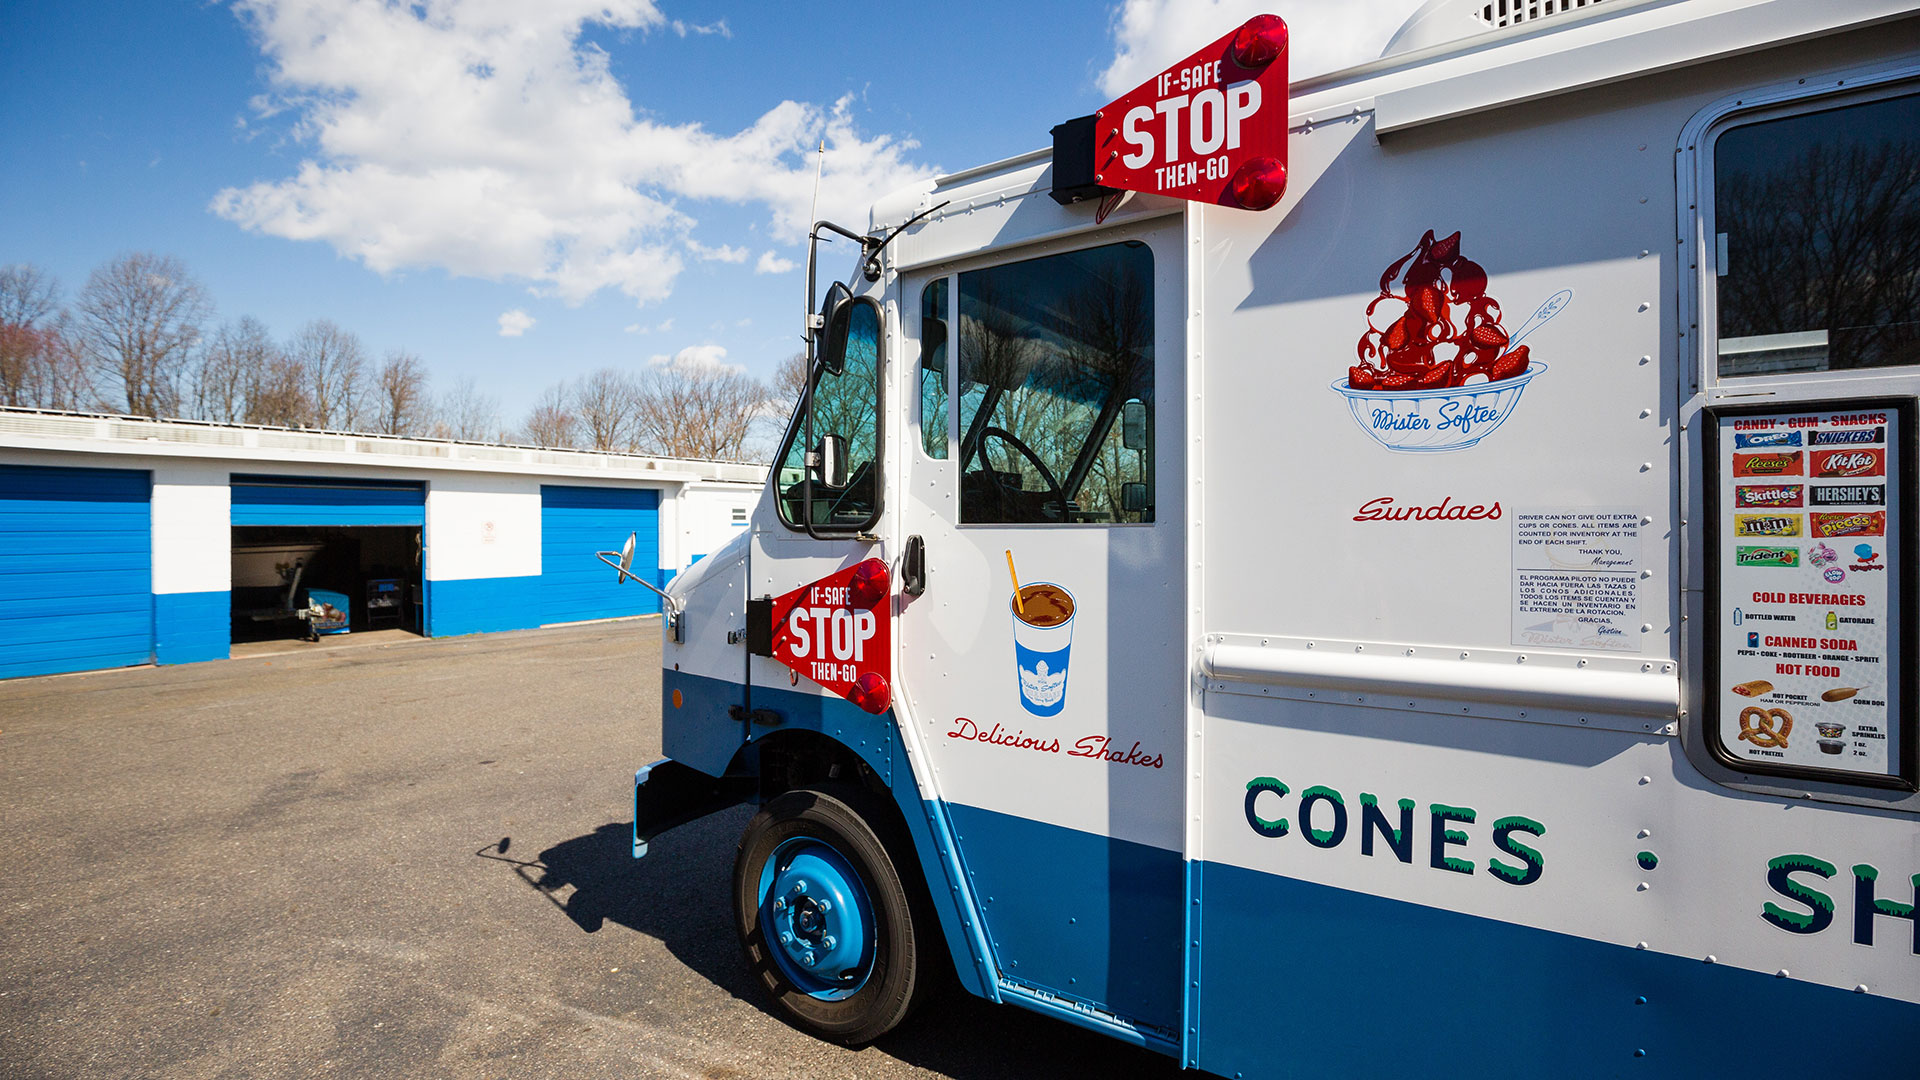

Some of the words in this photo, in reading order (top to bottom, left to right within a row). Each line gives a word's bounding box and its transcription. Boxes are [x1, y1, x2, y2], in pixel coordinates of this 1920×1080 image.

[1157, 59, 1223, 97] IF-SAFE
[1122, 79, 1262, 170] STOP
[1155, 155, 1229, 190] THEN-GO
[1371, 408, 1431, 431] Mister
[1436, 401, 1500, 434] Softee
[1733, 418, 1777, 431] CANDY
[1788, 417, 1819, 429] GUM
[1831, 413, 1888, 426] SNACKS
[1815, 430, 1876, 444] SNICKERS
[1745, 489, 1797, 503] Skittles
[1817, 487, 1880, 502] HERSHEY'S
[1352, 496, 1502, 522] Sundaes
[1820, 516, 1871, 537] Pieces
[1591, 556, 1634, 568] Management
[1738, 550, 1785, 563] Trident
[810, 586, 852, 606] IF-SAFE
[1752, 591, 1786, 604] COLD
[1789, 593, 1866, 606] BEVERAGES
[789, 607, 876, 662] STOP
[1765, 635, 1817, 649] CANNED
[1820, 638, 1858, 651] SODA
[1782, 652, 1817, 660] ROOTBEER
[1854, 655, 1880, 663] SPRITE
[811, 661, 857, 683] THEN-GO
[1775, 663, 1802, 676] HOT
[1805, 665, 1840, 678] FOOD
[947, 717, 1060, 753] Delicious
[1067, 735, 1164, 769] Shakes
[1852, 731, 1886, 740] SPRINKLES
[1761, 750, 1784, 758] PRETZEL
[1243, 776, 1546, 886] CONES
